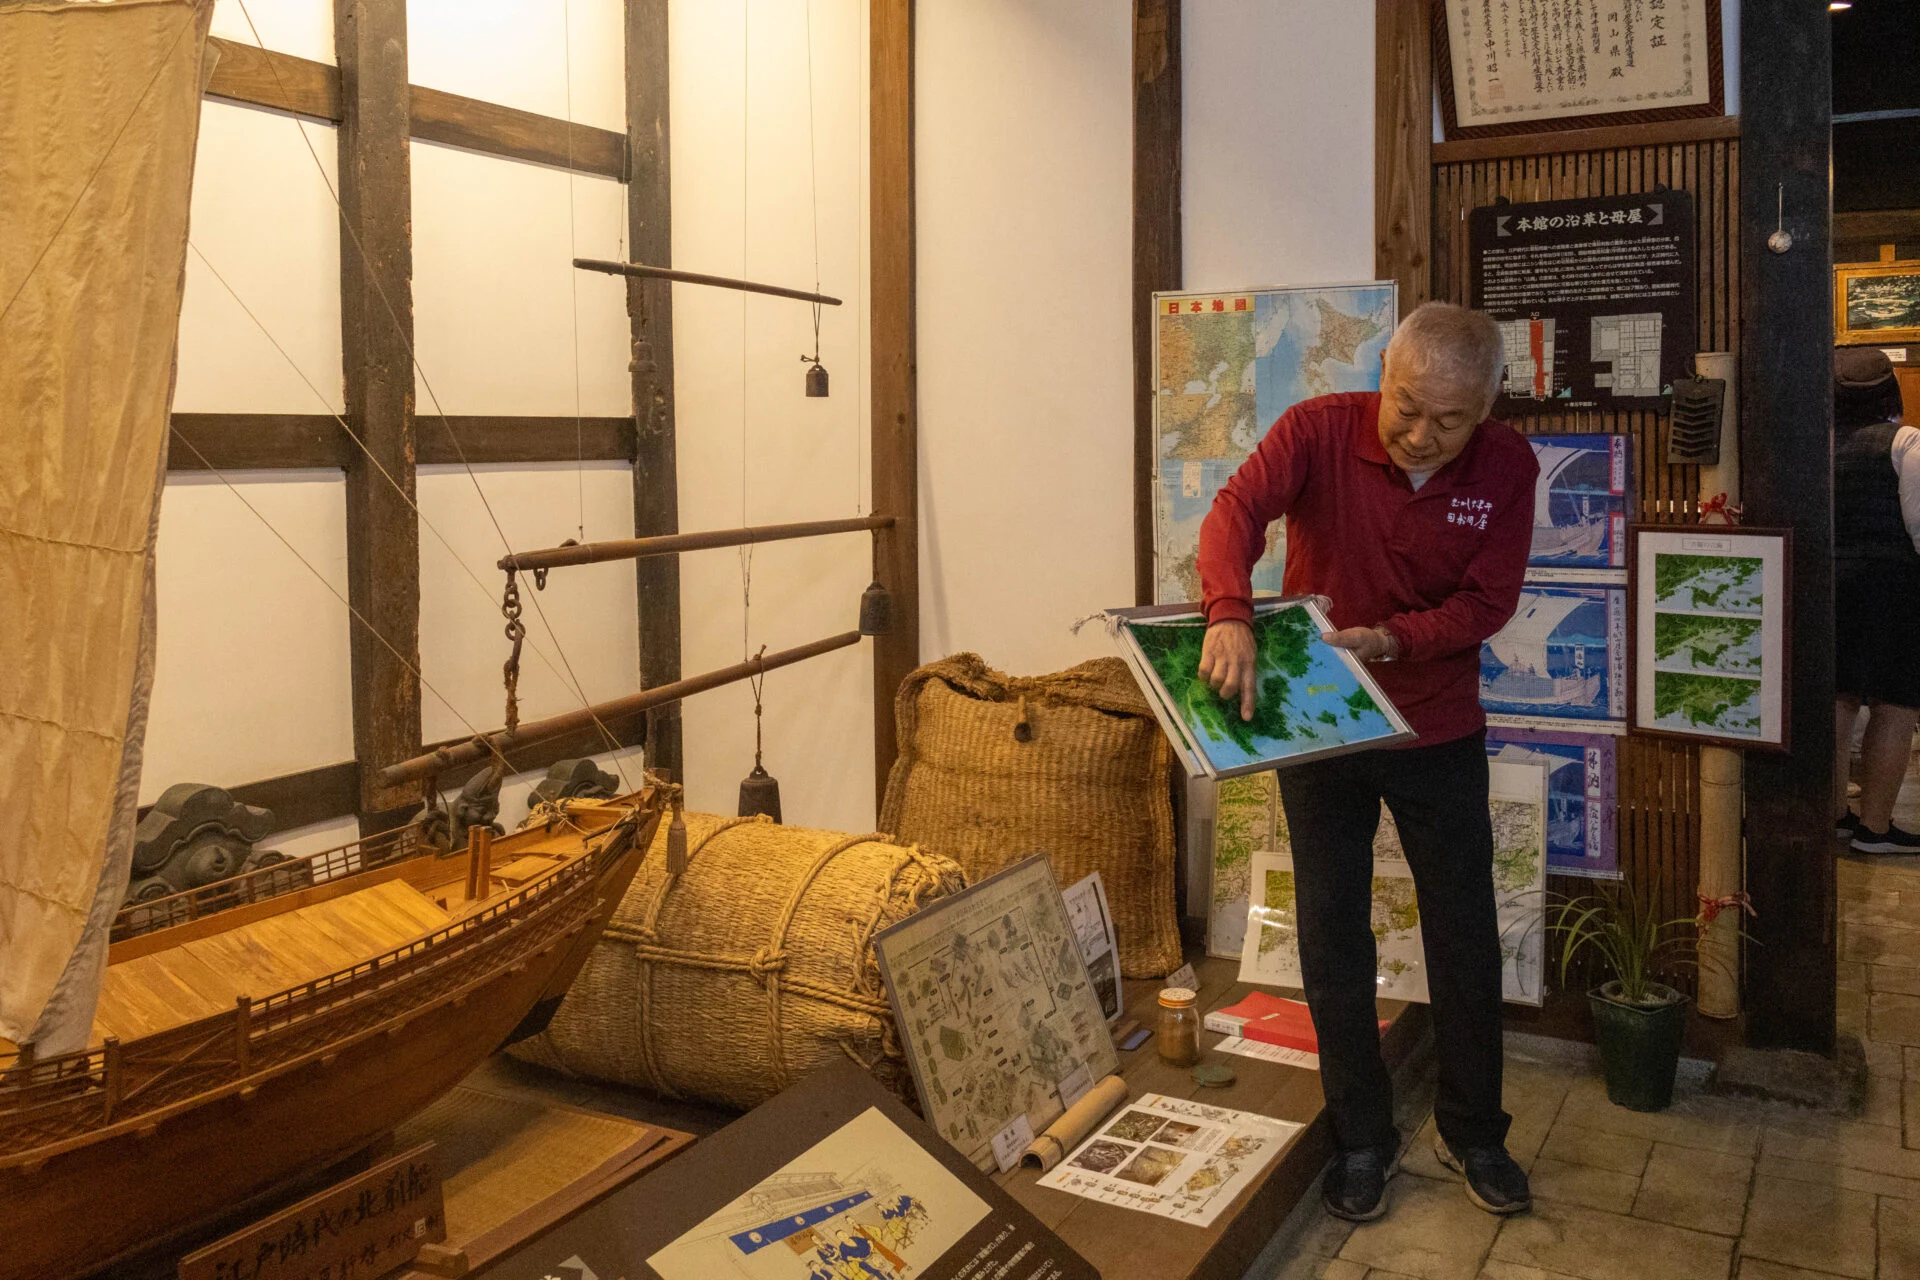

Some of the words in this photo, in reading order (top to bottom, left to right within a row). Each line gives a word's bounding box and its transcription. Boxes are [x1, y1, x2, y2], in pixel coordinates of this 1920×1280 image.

[1649, 0, 1667, 49] 認定証
[1515, 207, 1644, 232] 本館の沿革と母屋
[1168, 298, 1247, 315] 日本地図
